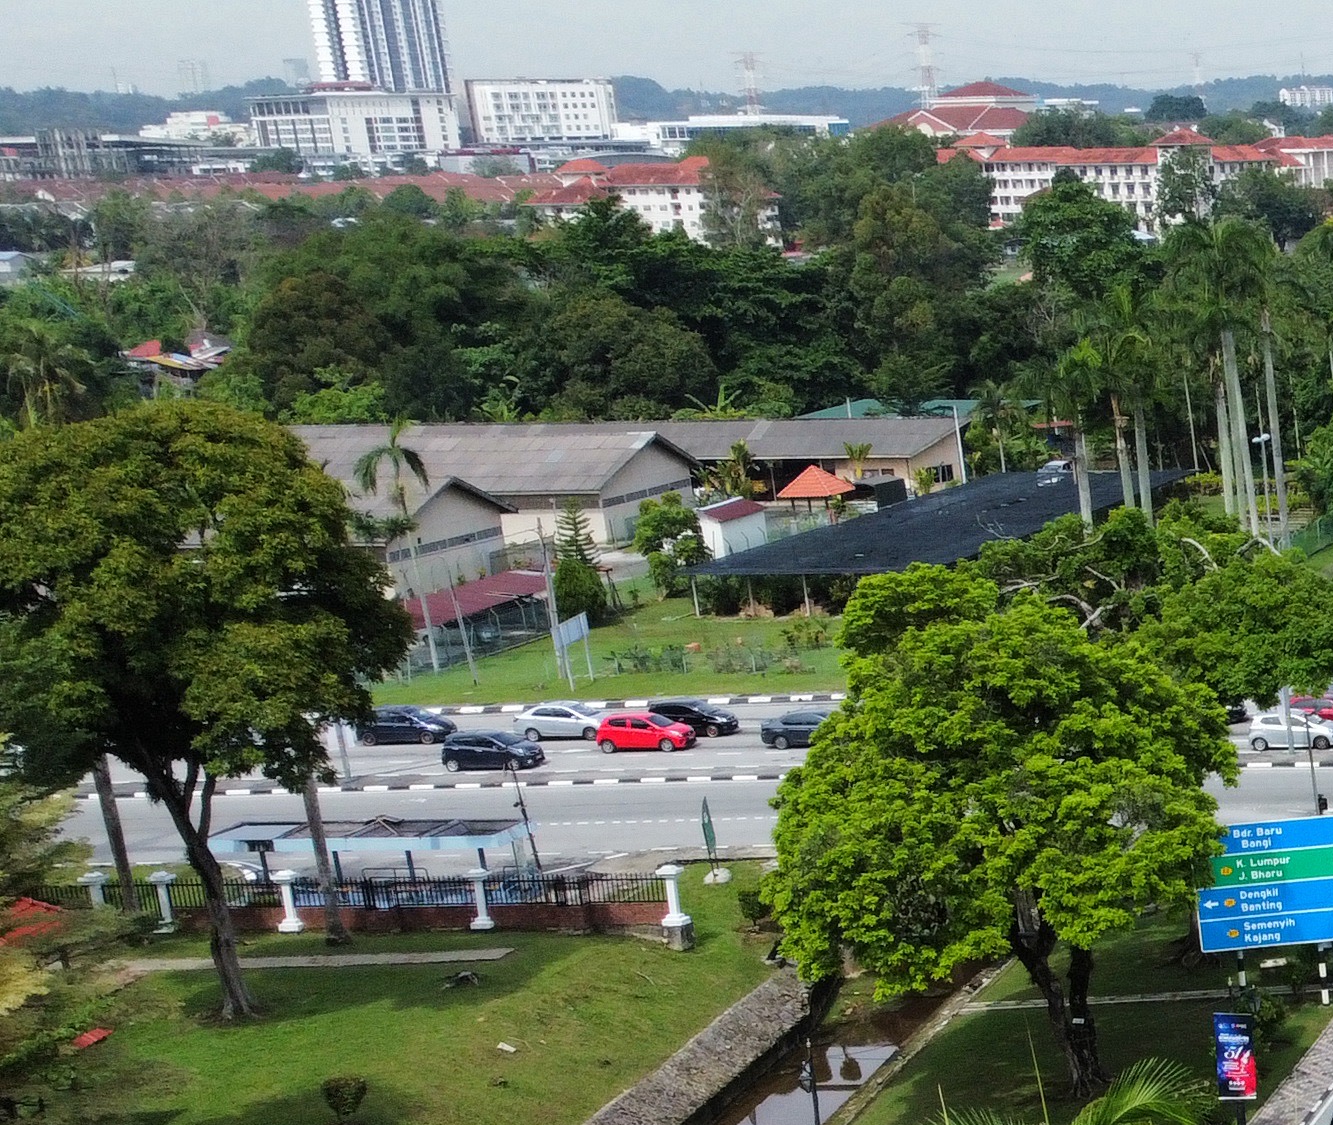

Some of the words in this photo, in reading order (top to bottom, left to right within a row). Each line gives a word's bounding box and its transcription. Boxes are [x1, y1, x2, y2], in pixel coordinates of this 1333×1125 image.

[1232, 829, 1254, 839] Bdr.
[1256, 827, 1283, 837] Baru
[1241, 837, 1272, 849] Bangi
[1236, 859, 1247, 869] K.
[1249, 856, 1291, 868] Lumpur
[1238, 871, 1248, 881] J.
[1250, 870, 1283, 880] Bharu
[1240, 887, 1279, 900] Dengkil
[1241, 900, 1283, 912] Banting
[1243, 918, 1296, 931] Semenyih
[1244, 932, 1281, 944] Kajang
